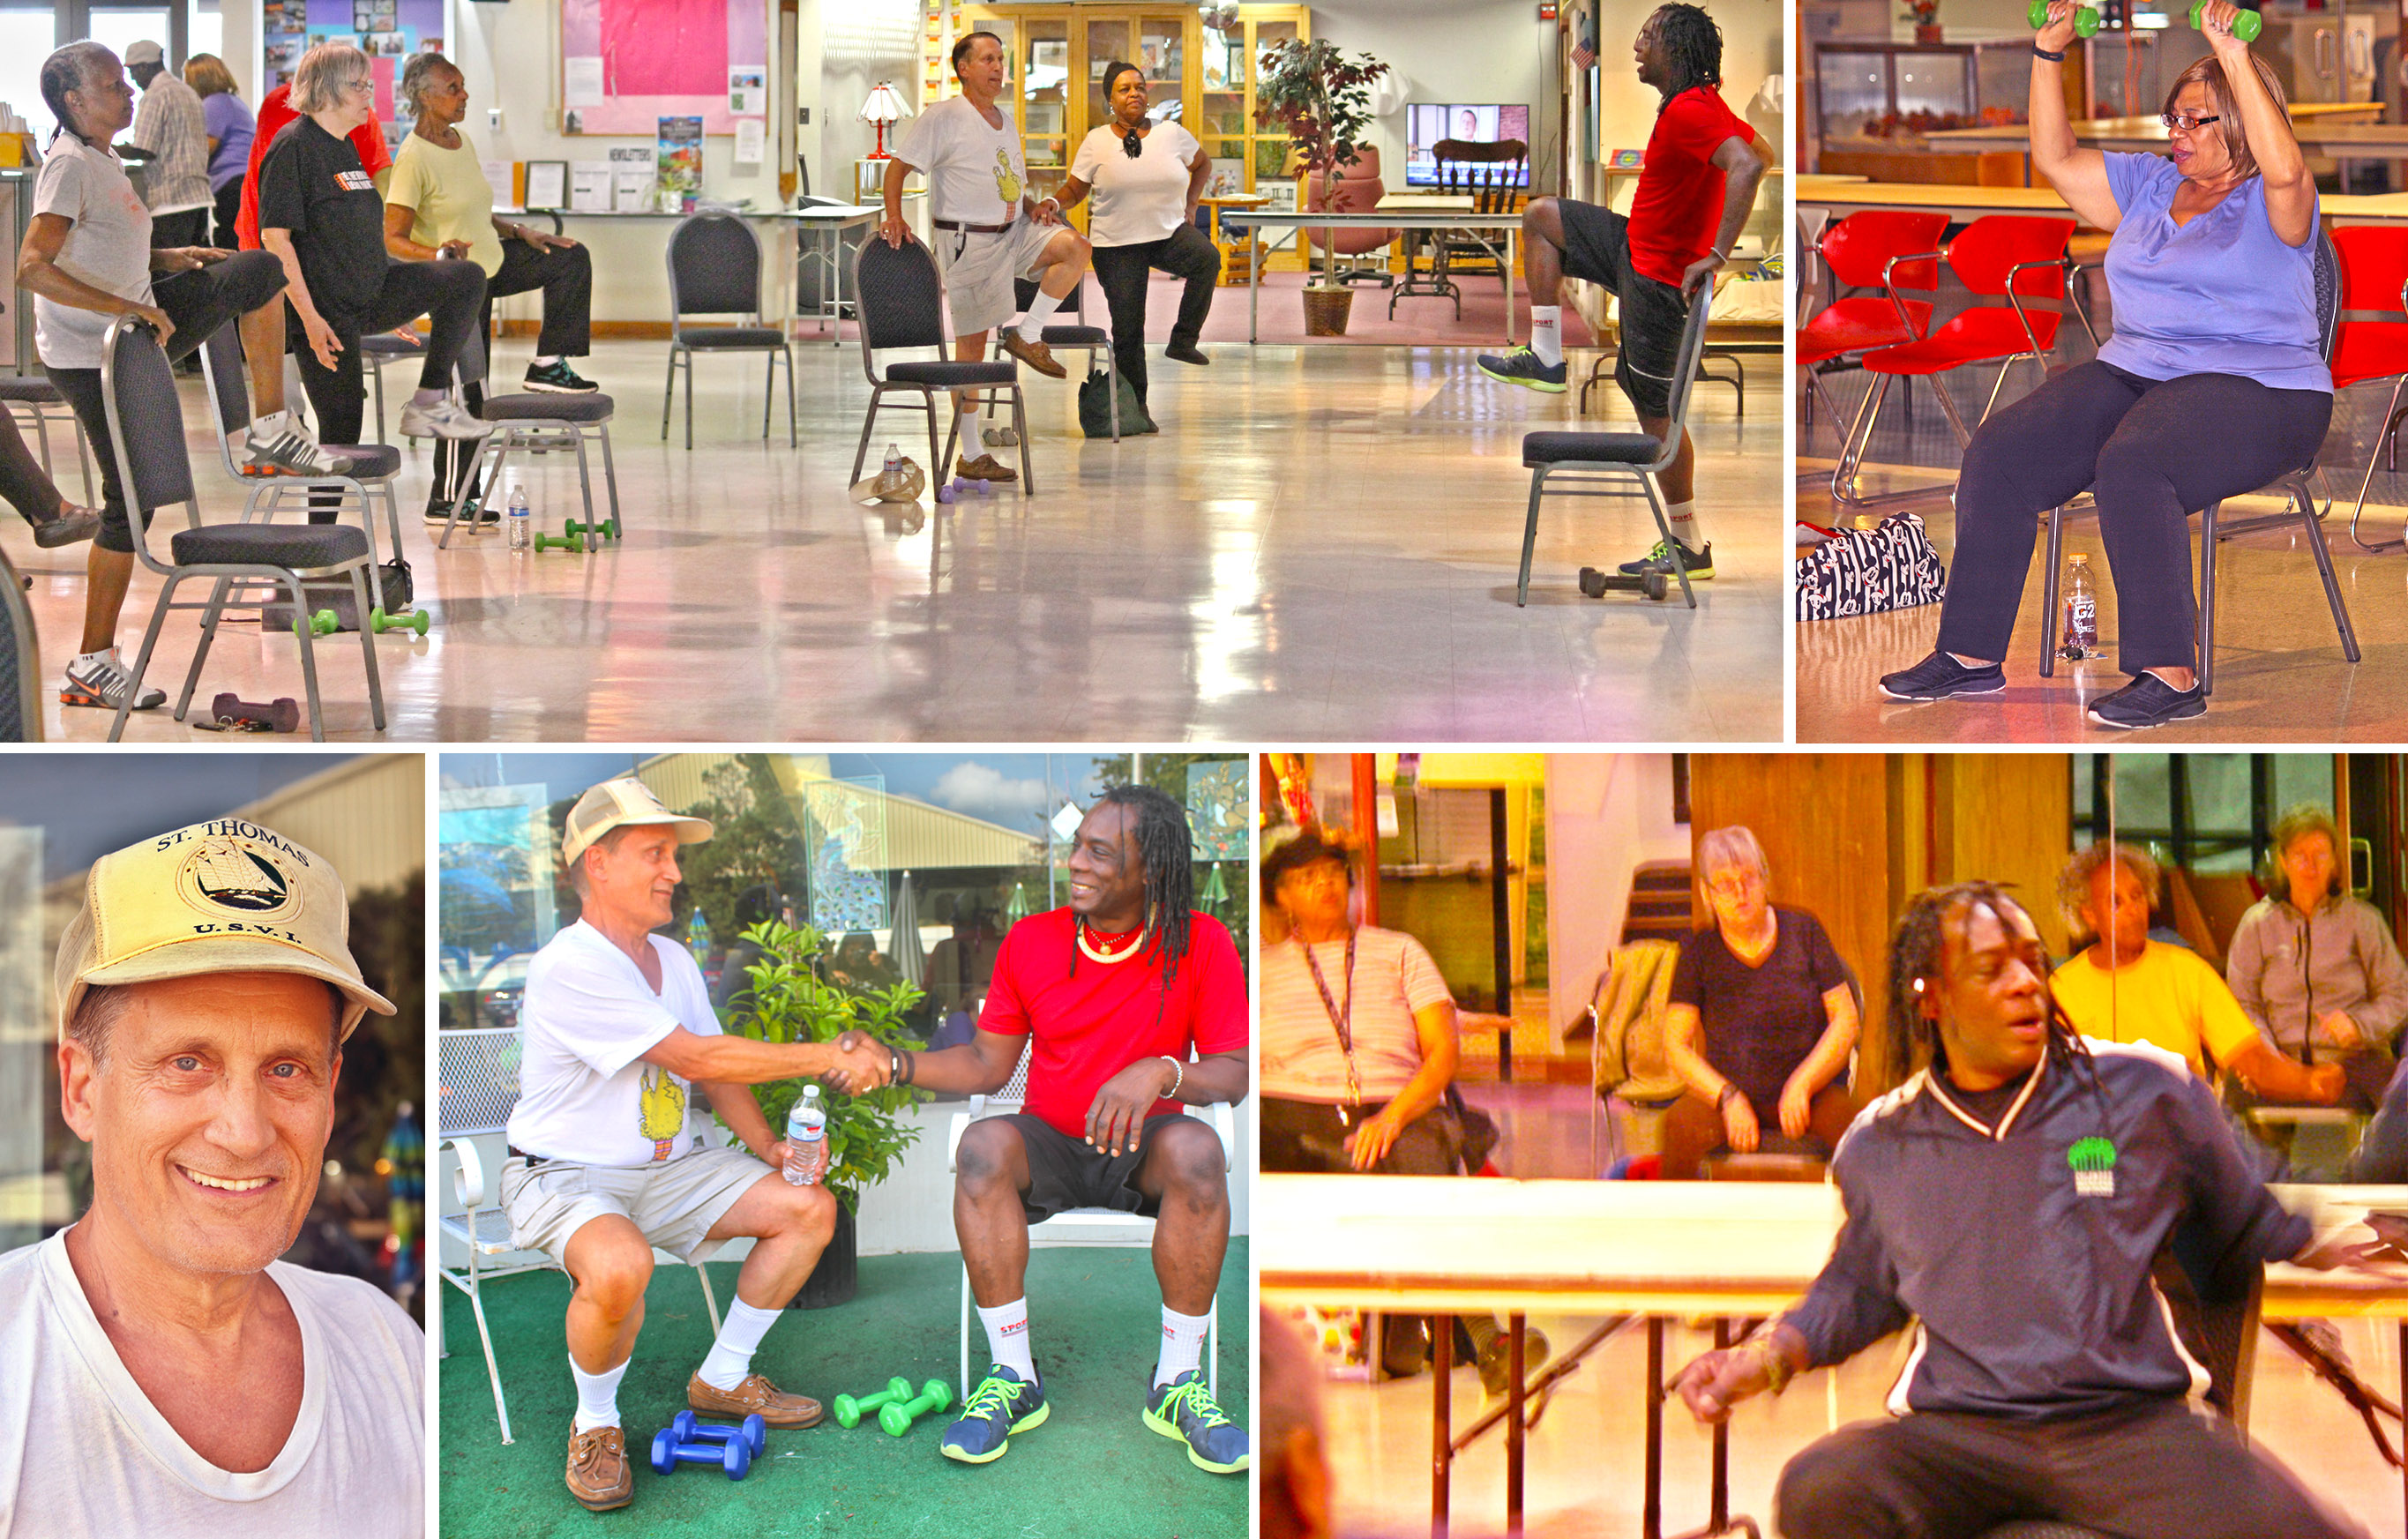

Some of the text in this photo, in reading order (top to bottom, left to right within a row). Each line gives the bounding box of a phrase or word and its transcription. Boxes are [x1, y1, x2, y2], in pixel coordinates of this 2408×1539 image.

[609, 147, 651, 161] NEWSLETTERS
[2074, 603, 2095, 619] G2
[157, 819, 310, 867] ST. THOMAS
[193, 923, 302, 944] U.S.V.I.
[1000, 1319, 1028, 1334] SPOR
